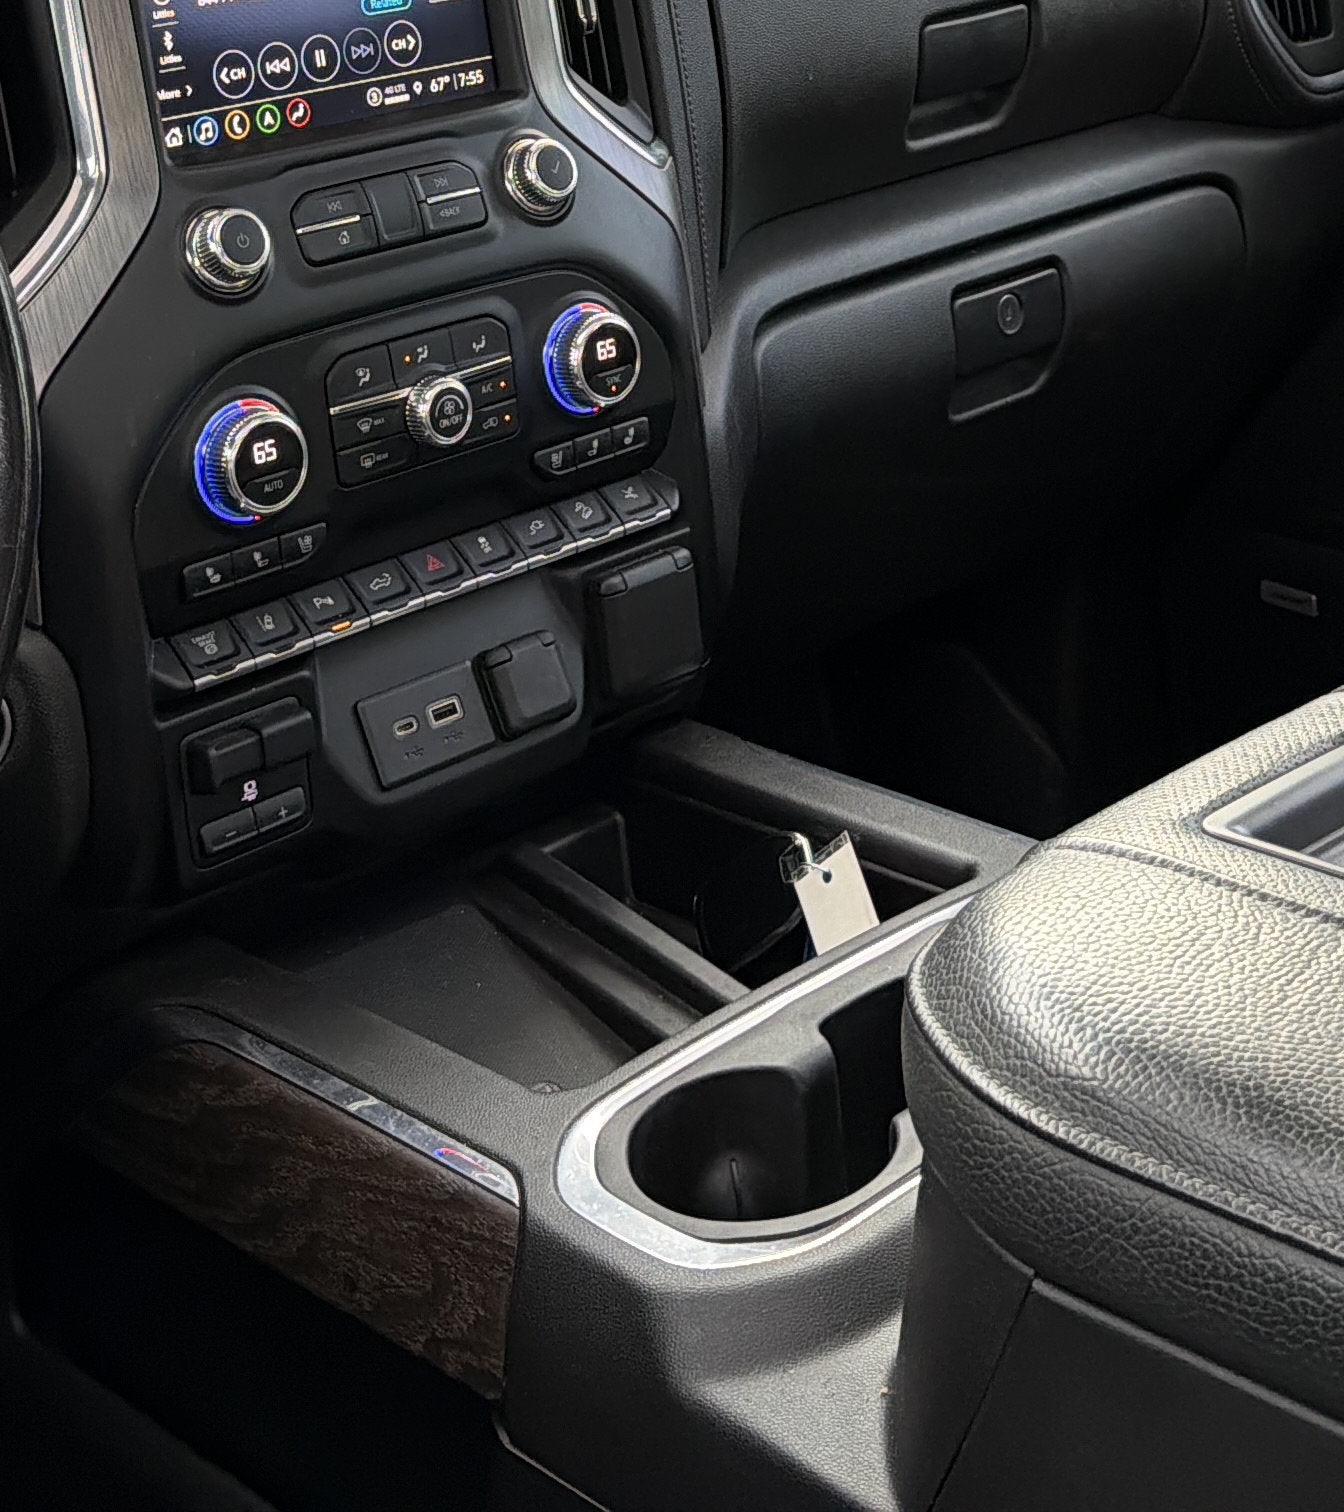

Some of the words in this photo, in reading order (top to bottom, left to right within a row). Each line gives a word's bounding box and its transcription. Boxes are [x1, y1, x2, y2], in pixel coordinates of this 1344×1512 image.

[391, 39, 407, 51] CH
[230, 66, 248, 81] CH
[429, 74, 451, 93] 67°
[457, 68, 485, 88] 7:55
[156, 88, 182, 101] More
[596, 337, 617, 362] 65
[439, 414, 464, 429] ON/OFF
[252, 438, 278, 465] 65
[263, 478, 284, 494] AUTO
